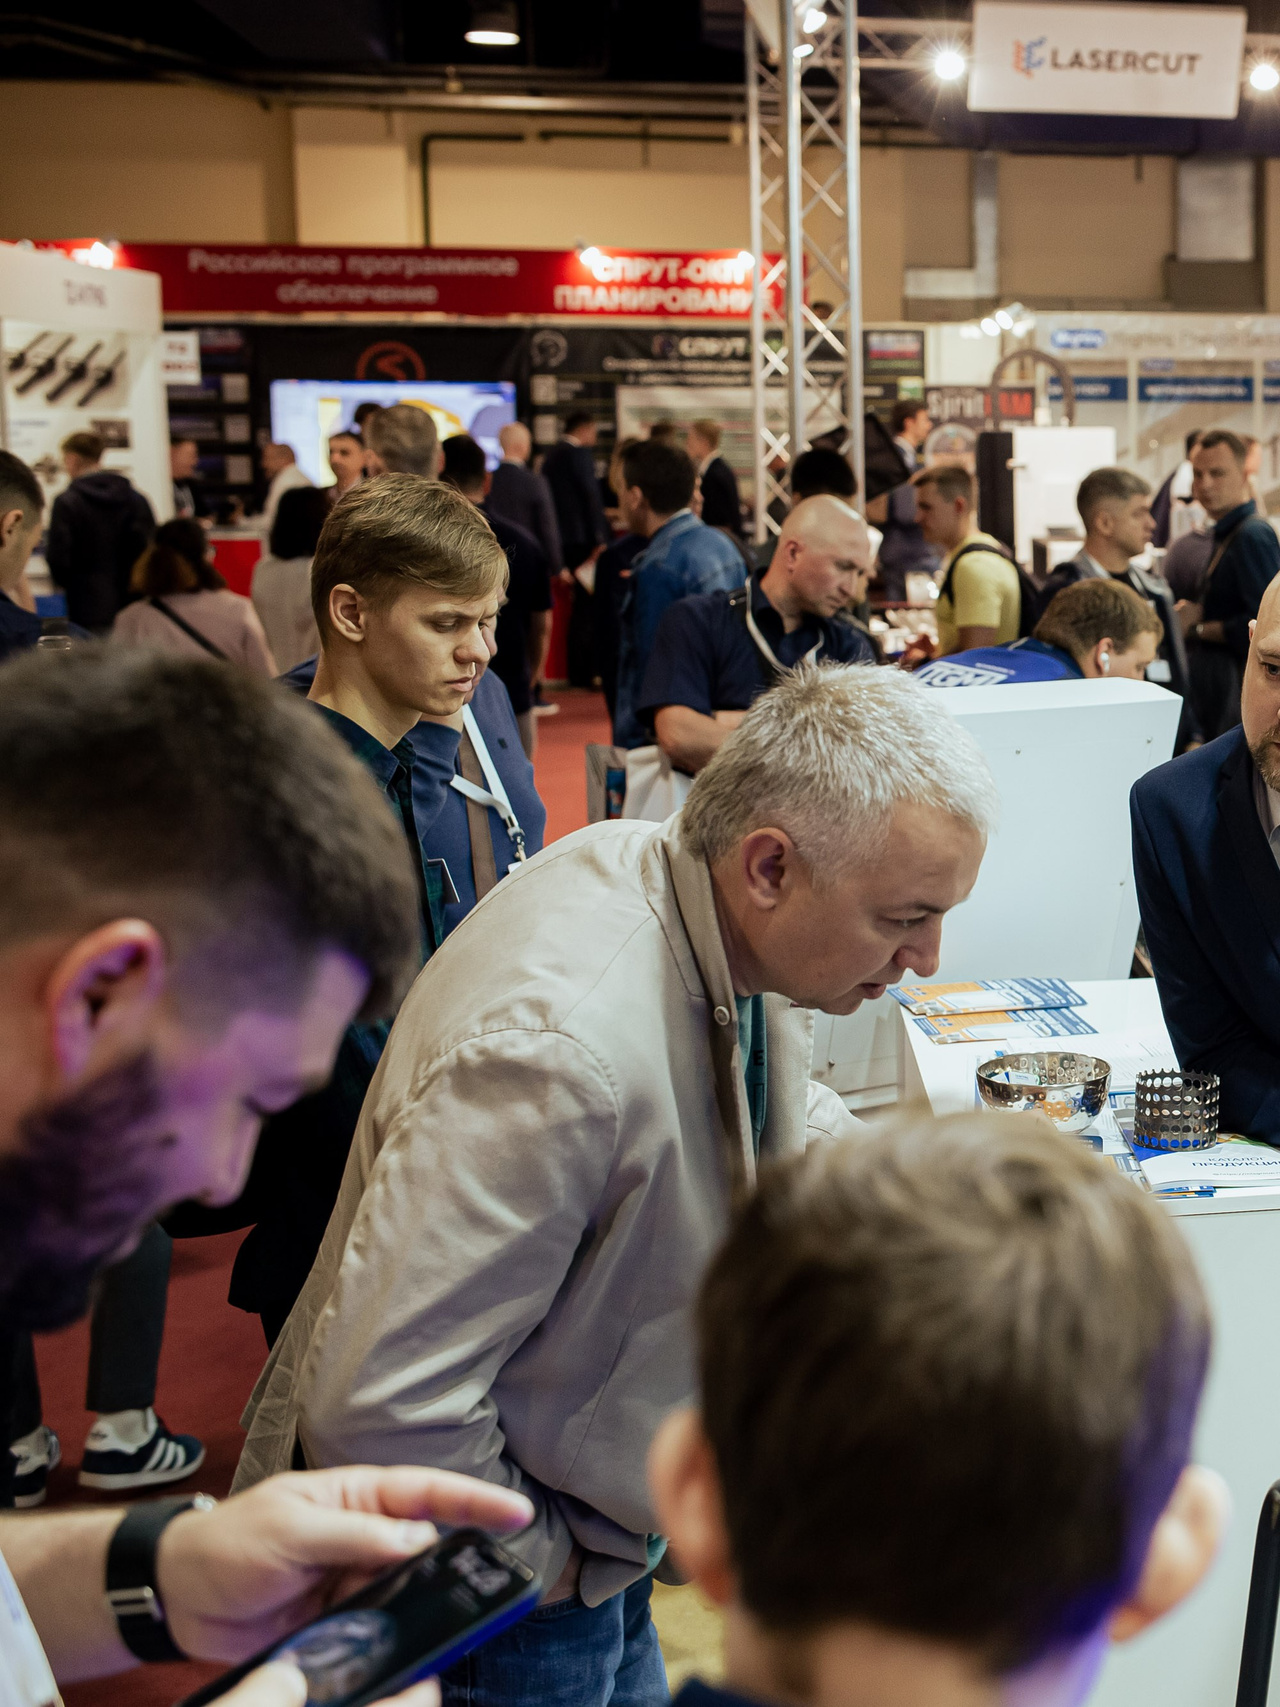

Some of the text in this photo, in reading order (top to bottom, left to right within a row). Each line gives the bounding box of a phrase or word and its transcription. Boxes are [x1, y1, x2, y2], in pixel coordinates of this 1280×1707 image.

[1050, 47, 1202, 76] LASERCUT
[188, 248, 519, 280] Российское программное
[276, 278, 439, 304] обеспечение
